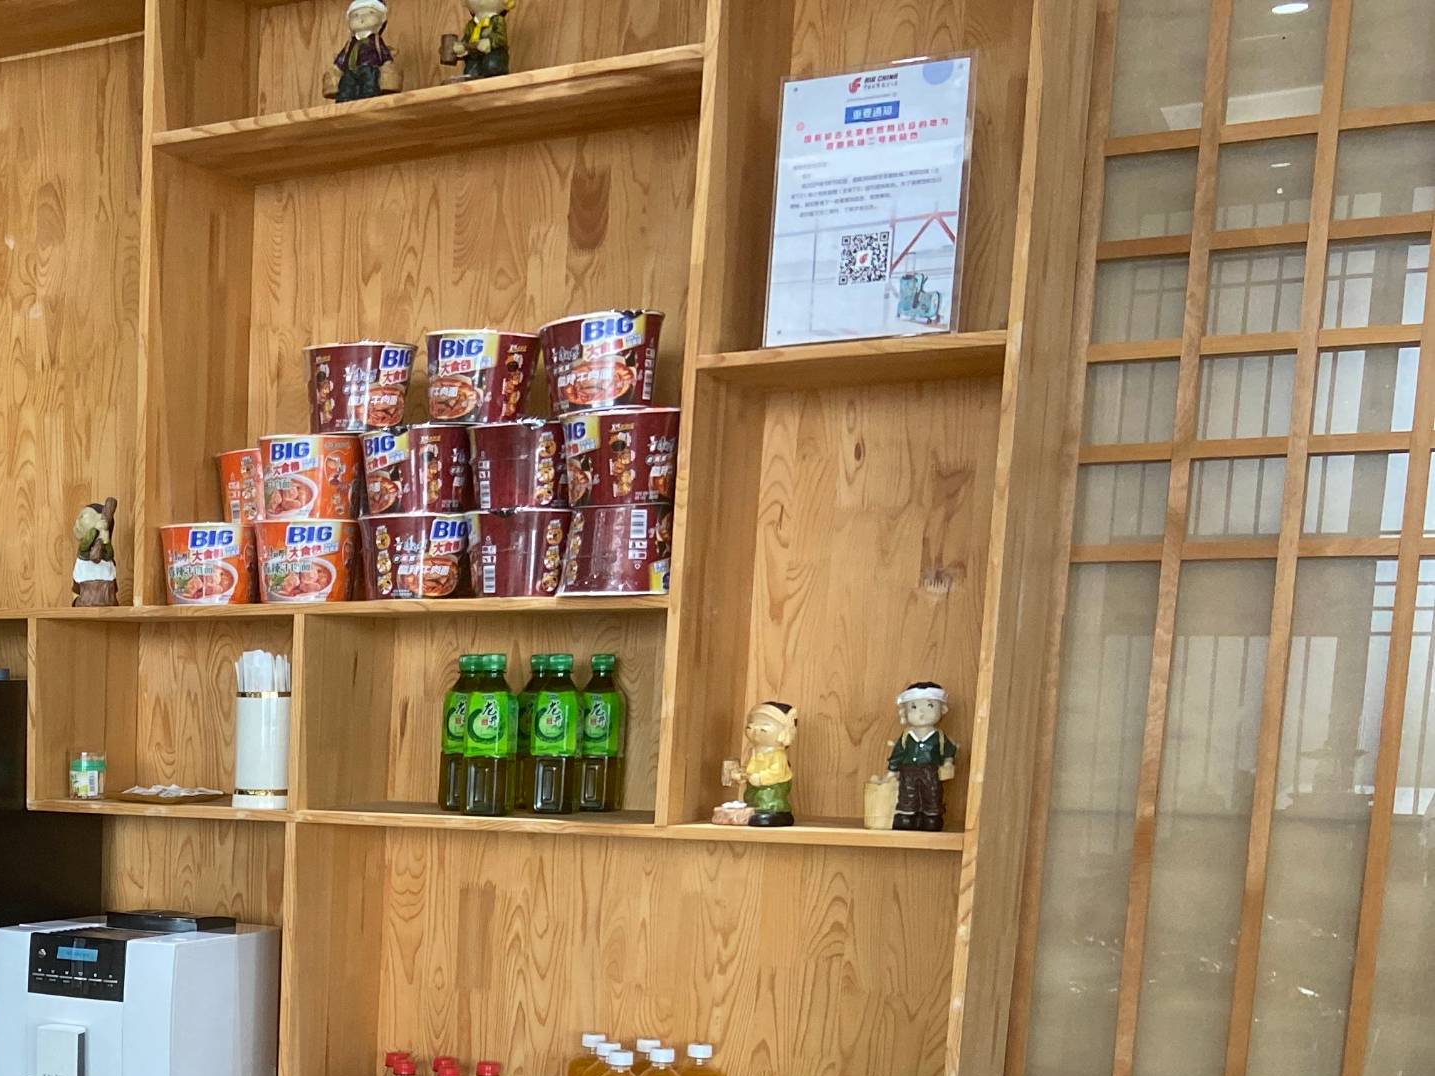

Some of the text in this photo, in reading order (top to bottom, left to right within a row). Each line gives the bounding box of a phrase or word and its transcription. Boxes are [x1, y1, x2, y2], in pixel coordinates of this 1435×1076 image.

[584, 317, 634, 343] BIG
[440, 339, 484, 359] BIG
[564, 422, 586, 442] IG
[271, 442, 310, 461] BIG
[365, 435, 395, 458] BIG
[190, 530, 233, 549] BIG
[288, 527, 332, 545] BIG
